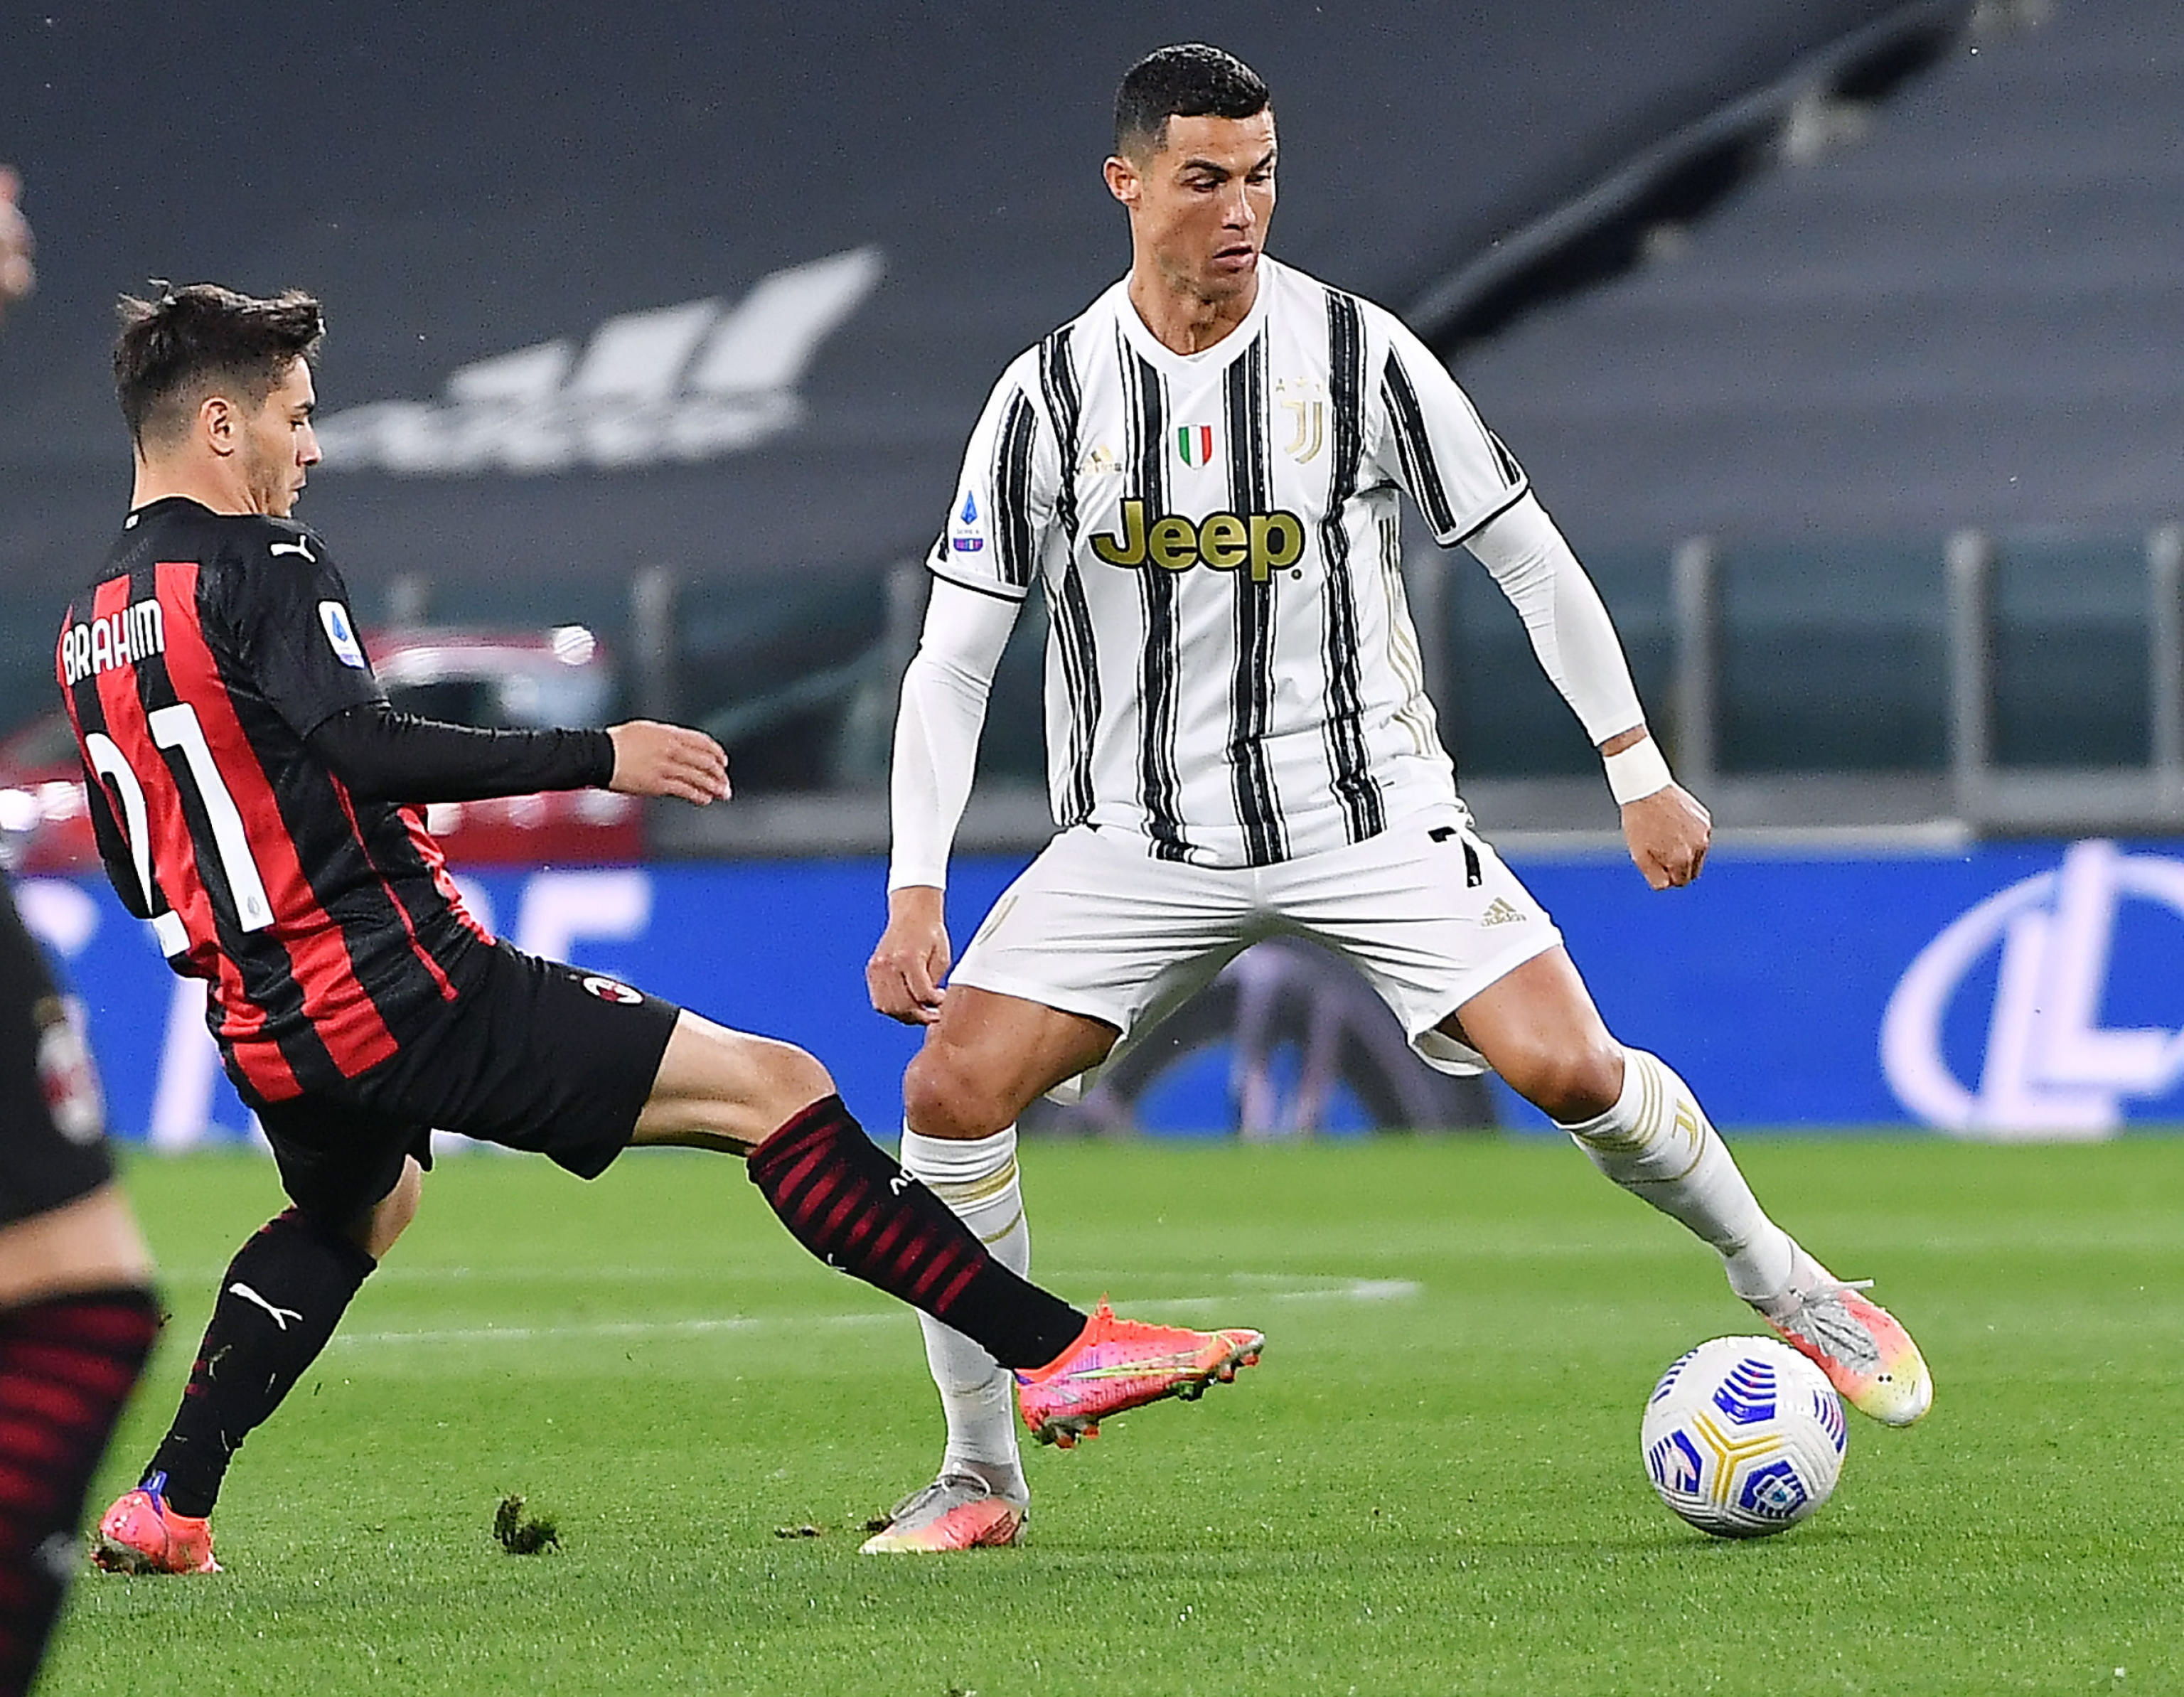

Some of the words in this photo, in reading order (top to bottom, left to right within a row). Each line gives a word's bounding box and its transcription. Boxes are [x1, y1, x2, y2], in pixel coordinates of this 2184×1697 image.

[1090, 499, 1303, 582] Jeep
[62, 599, 165, 686] BRAHIM
[85, 702, 275, 958] 21
